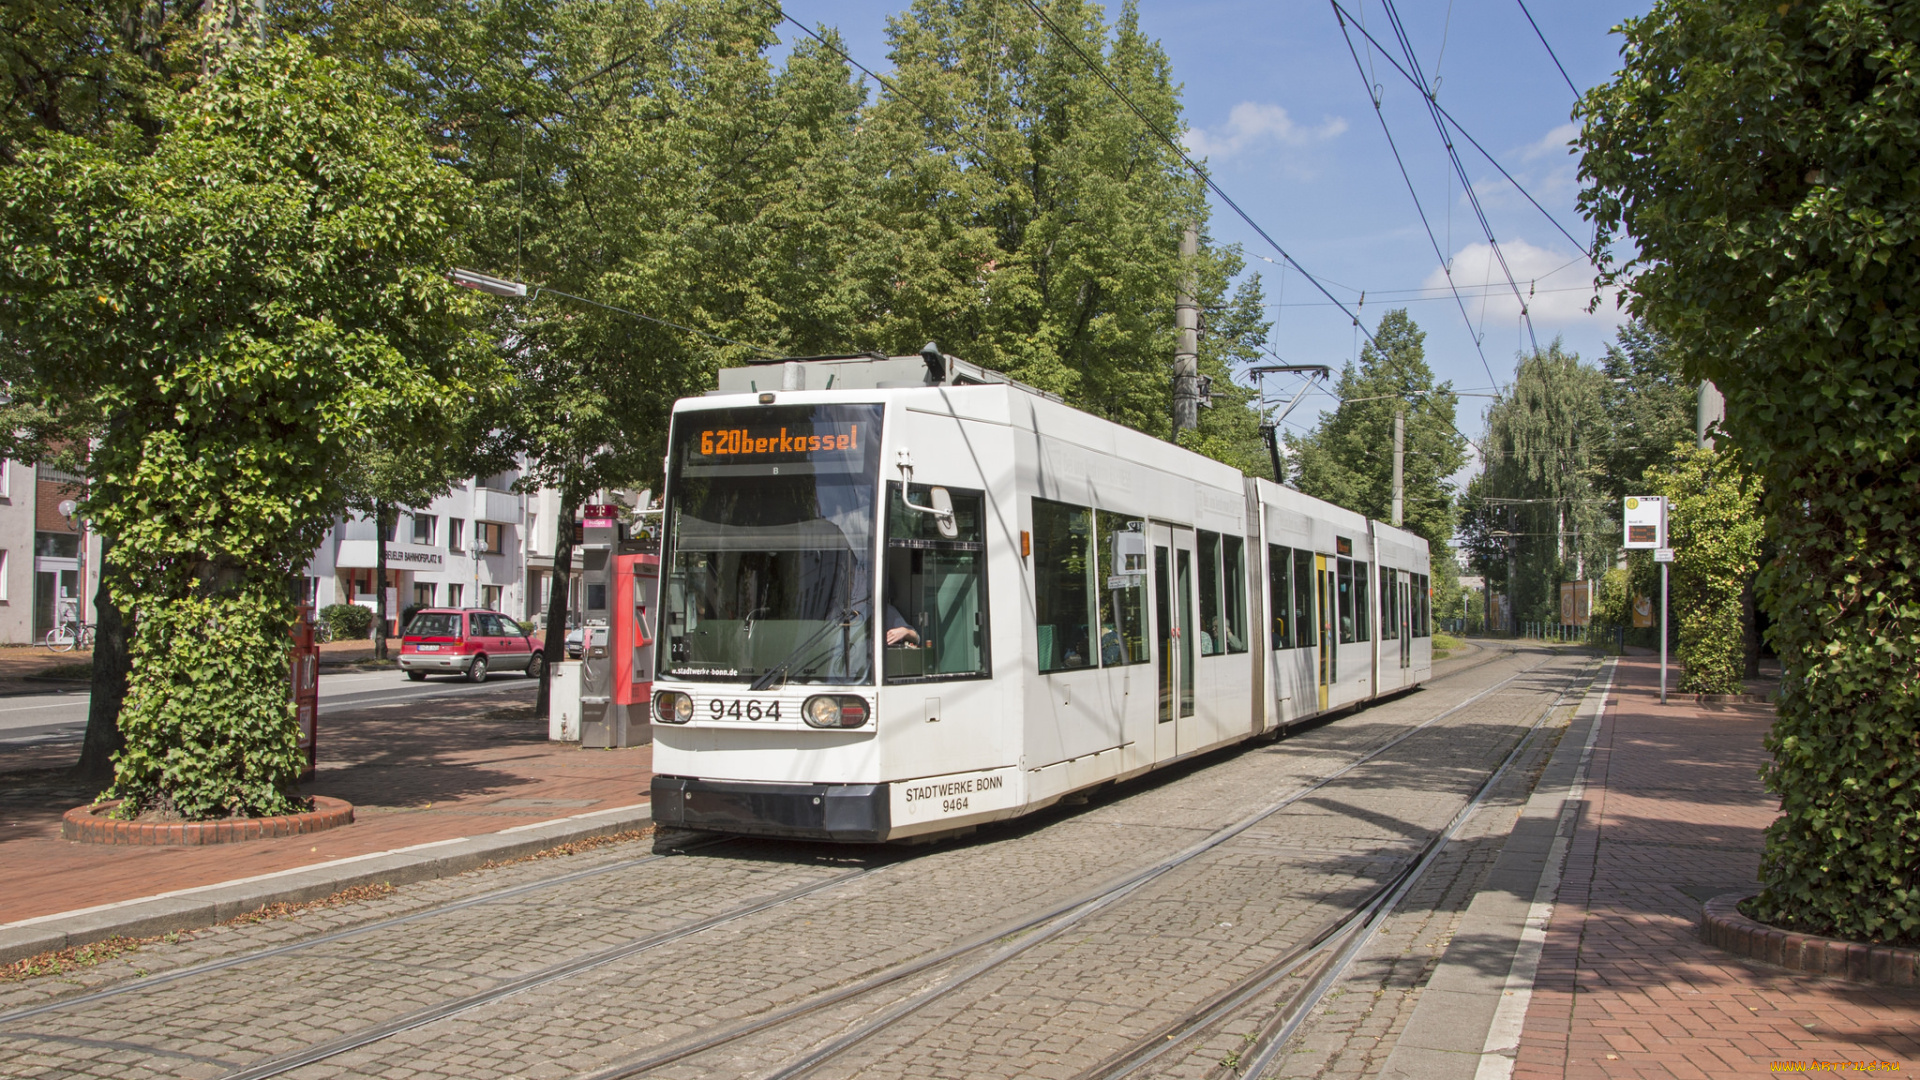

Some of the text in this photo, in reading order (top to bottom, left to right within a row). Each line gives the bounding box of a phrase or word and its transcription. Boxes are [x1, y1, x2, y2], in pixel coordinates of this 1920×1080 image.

[404, 551, 437, 563] BAHNHOFSPLATZ
[709, 699, 782, 722] 9464
[905, 775, 1003, 802] STADTWERKE BONN
[943, 797, 969, 813] 9464
